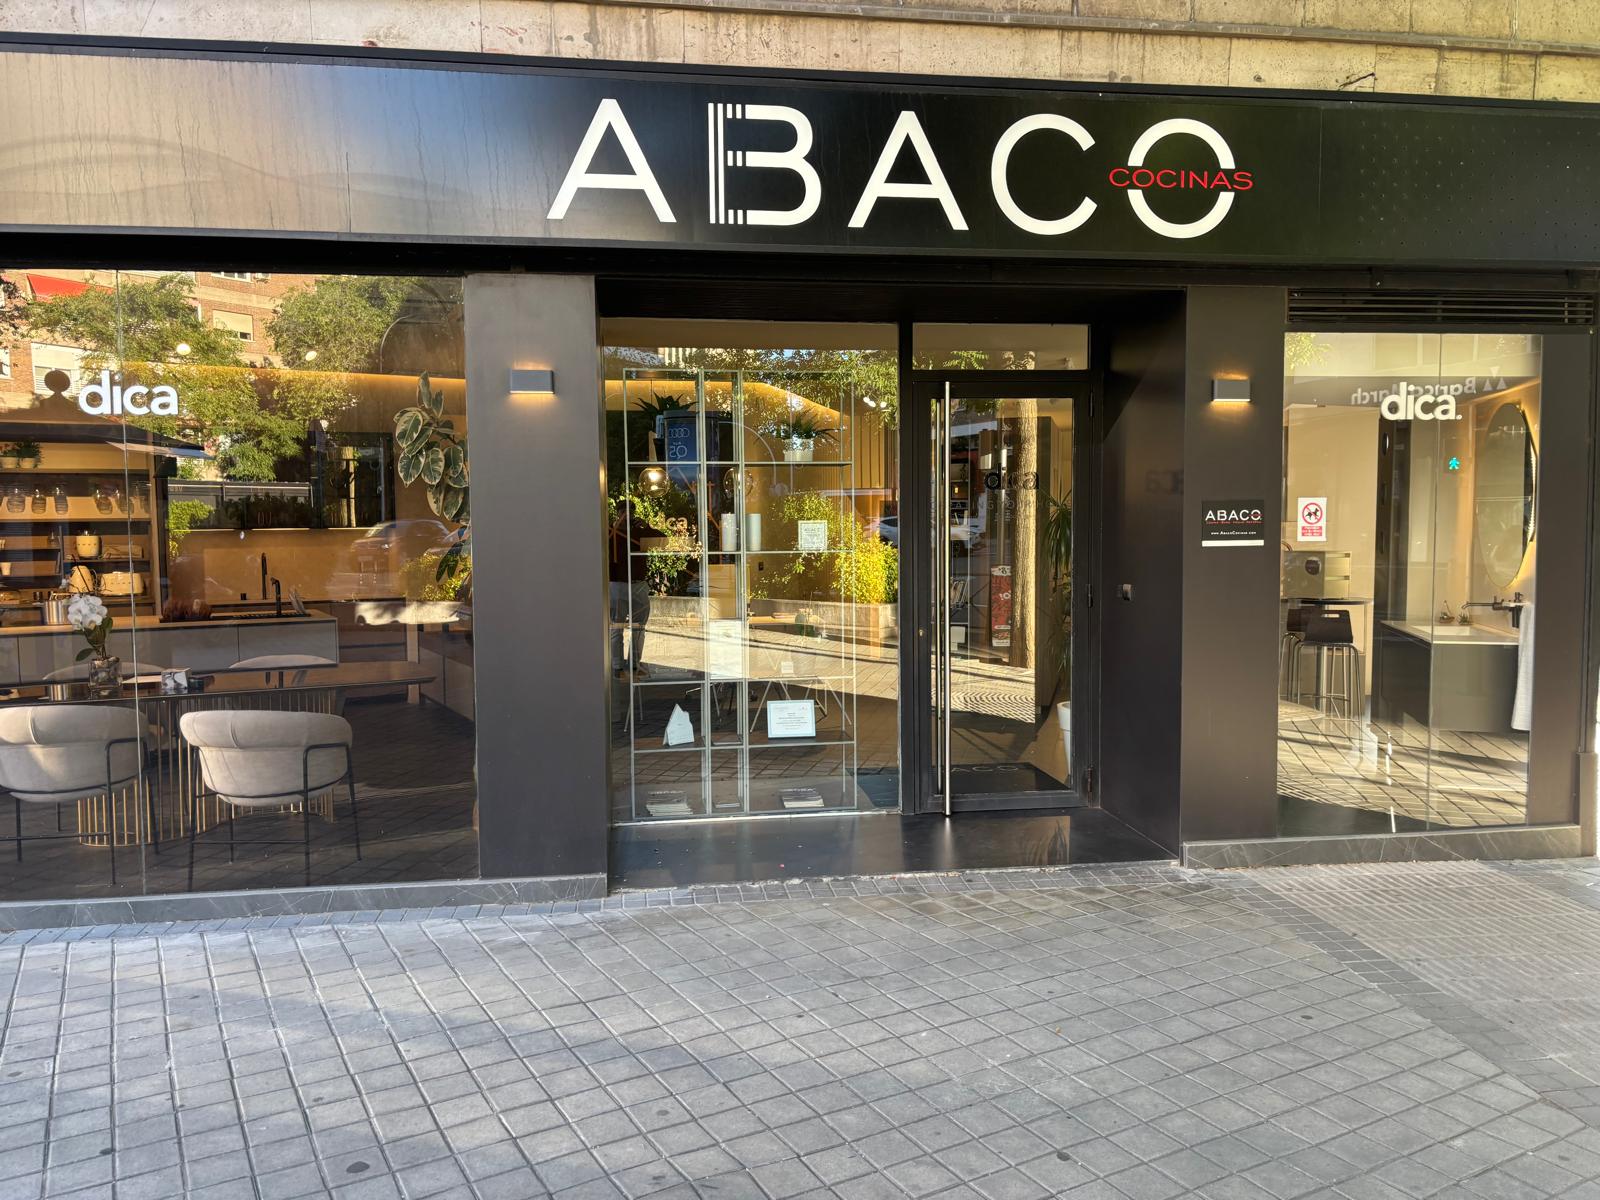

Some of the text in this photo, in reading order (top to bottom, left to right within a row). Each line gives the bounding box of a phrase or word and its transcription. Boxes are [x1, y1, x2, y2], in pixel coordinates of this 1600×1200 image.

[547, 98, 1236, 239] ABACO
[1109, 167, 1254, 191] COCINAS
[79, 369, 179, 416] dica
[1206, 510, 1262, 521] ABACO
